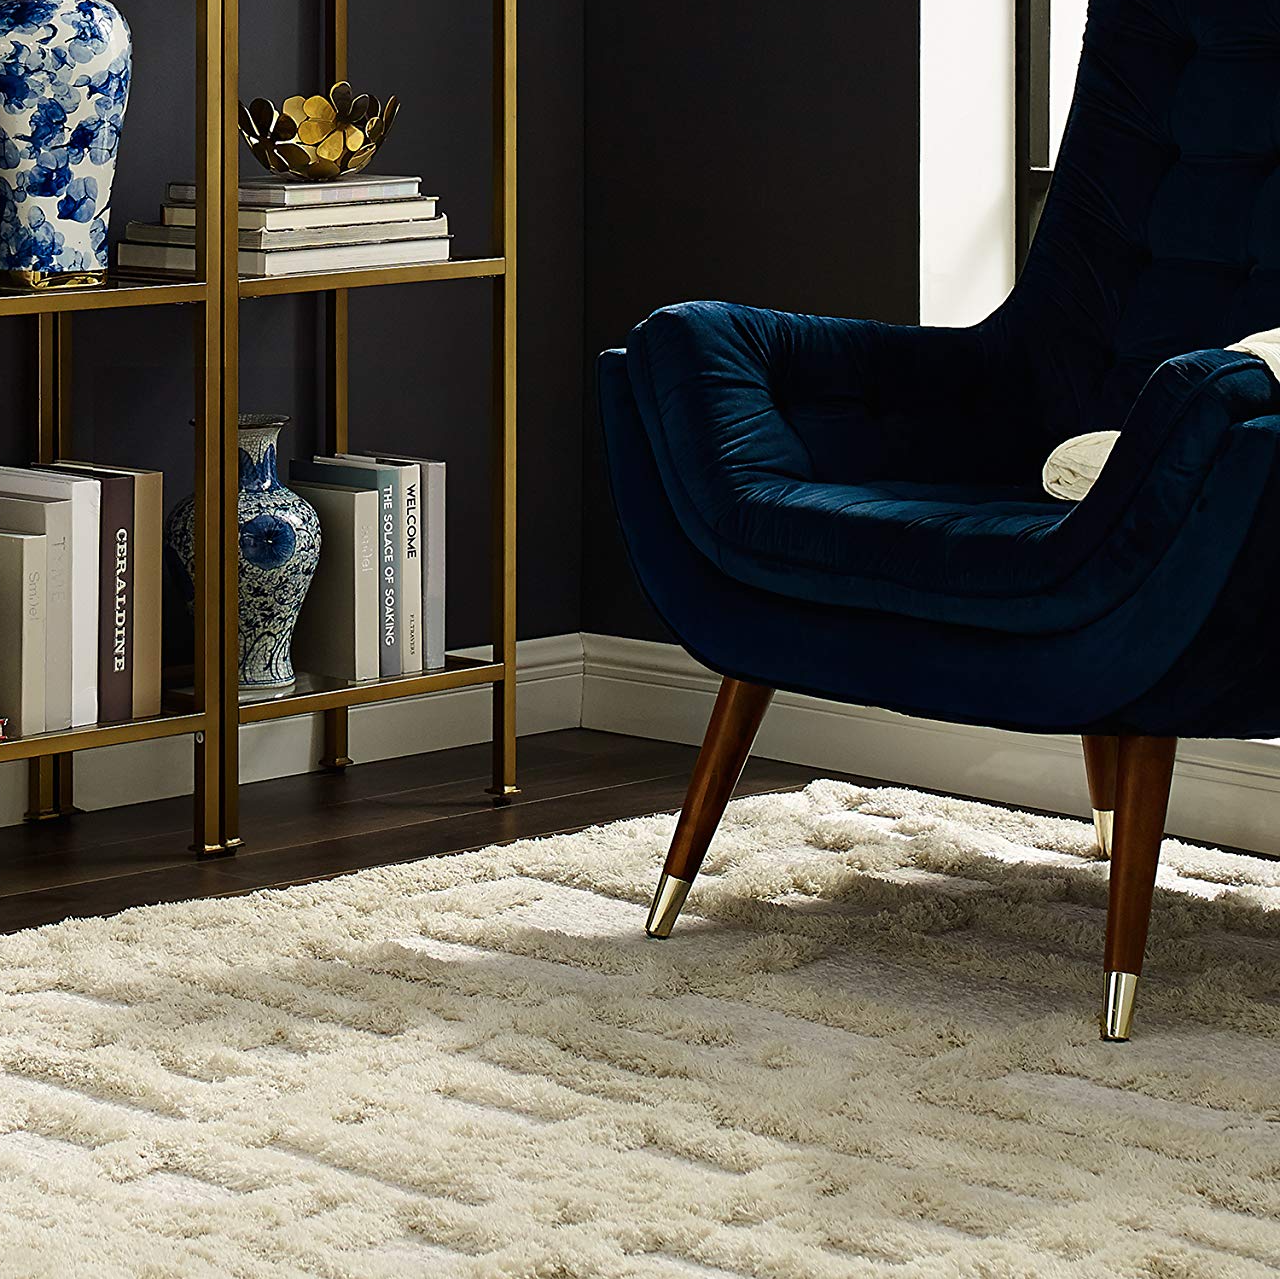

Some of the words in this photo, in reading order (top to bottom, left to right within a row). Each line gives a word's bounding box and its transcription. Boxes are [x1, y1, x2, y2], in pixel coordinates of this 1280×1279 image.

[382, 484, 393, 509] THE
[405, 483, 418, 560] WELCOME
[383, 513, 394, 563] SOLACE
[384, 567, 394, 584] OF
[384, 588, 395, 646] SOAKING
